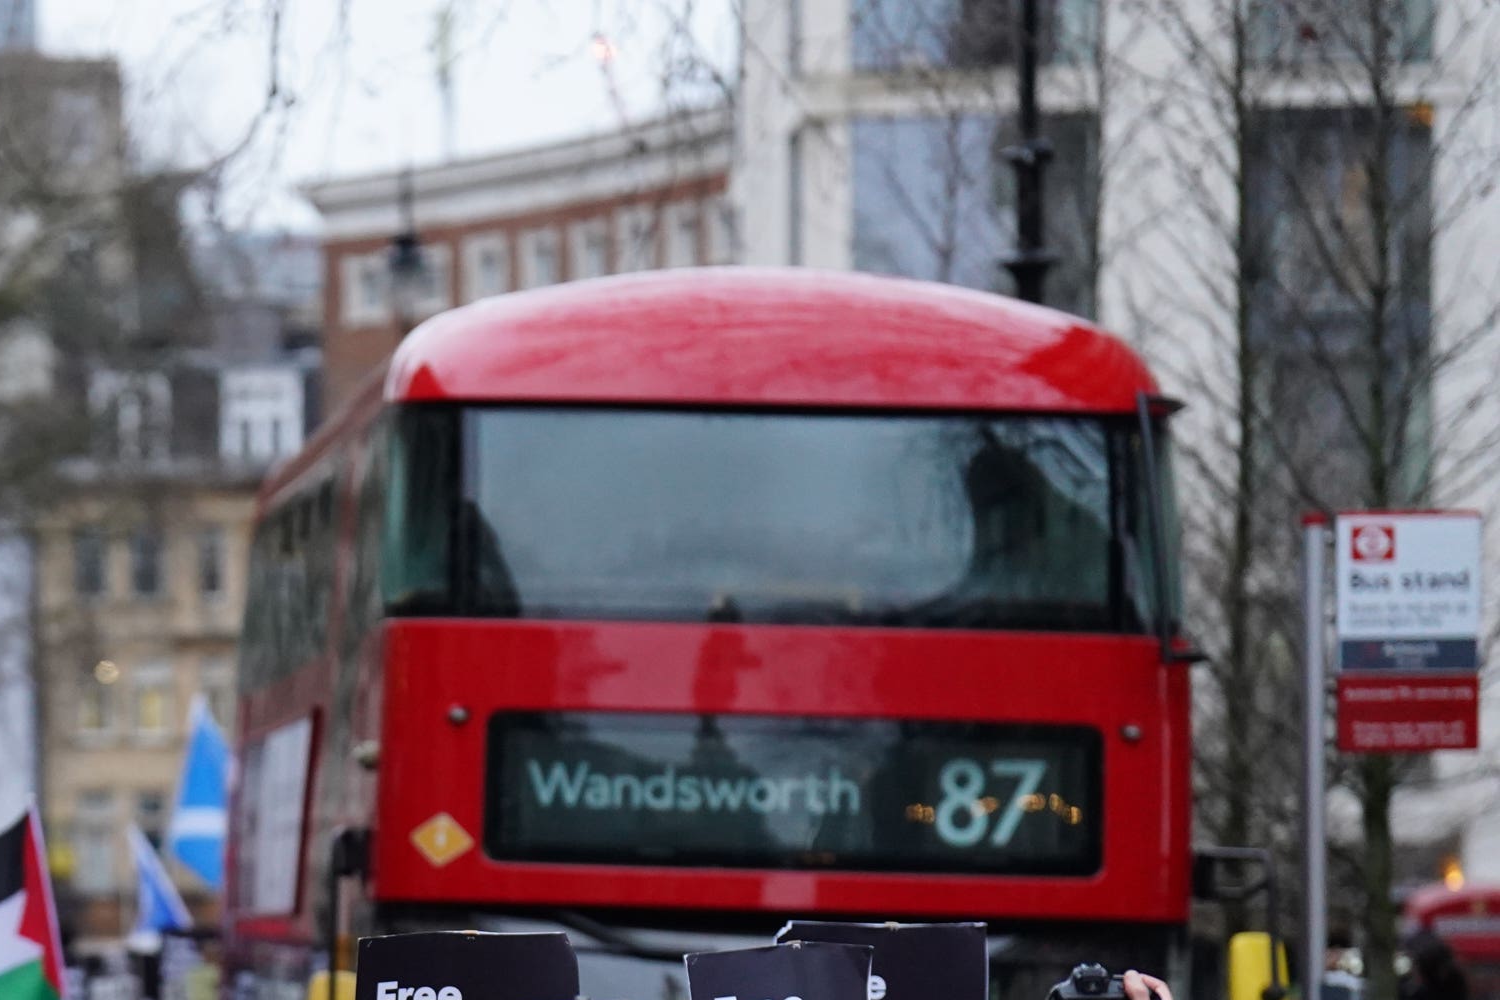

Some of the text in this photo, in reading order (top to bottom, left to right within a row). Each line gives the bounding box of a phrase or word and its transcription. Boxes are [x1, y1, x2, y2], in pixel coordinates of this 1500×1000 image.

[1352, 570, 1469, 588] Bus stand
[527, 758, 1047, 847] Wandsworth 87
